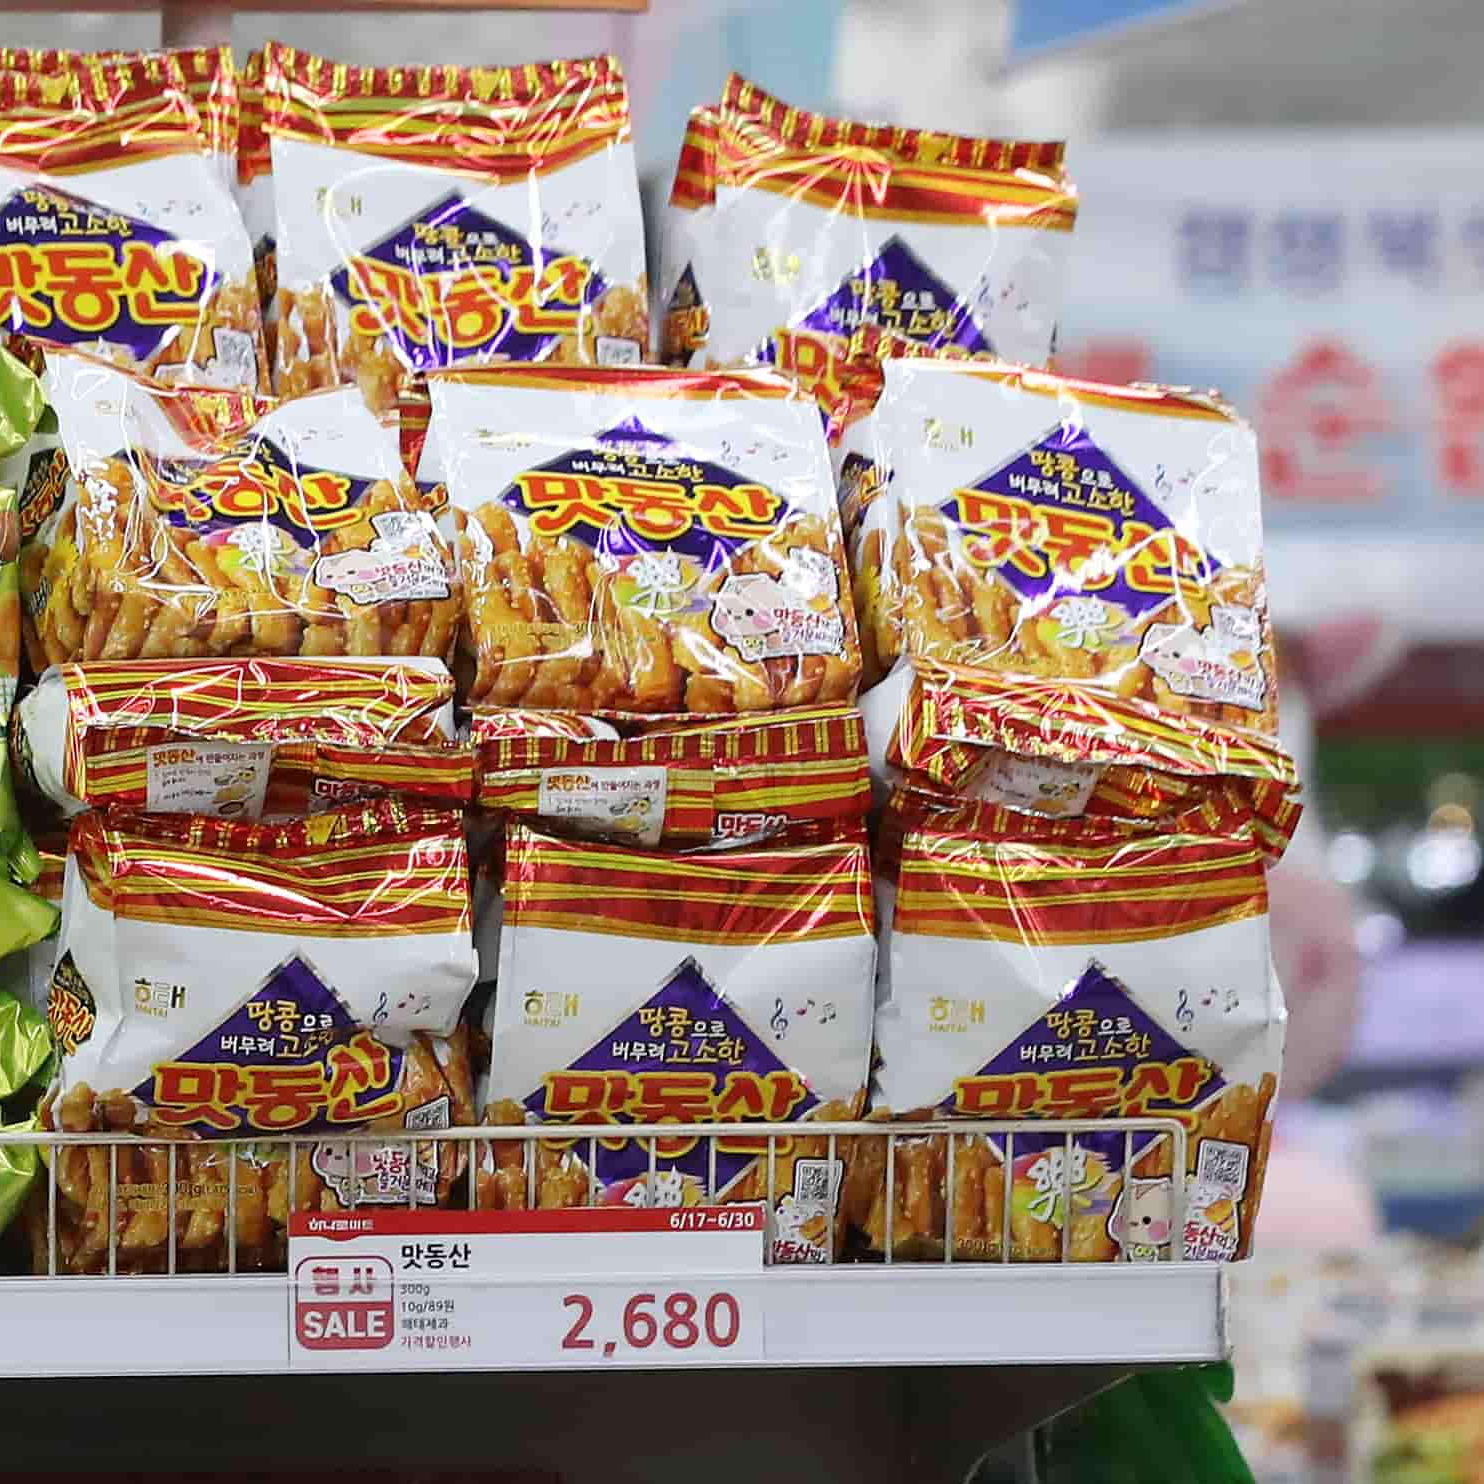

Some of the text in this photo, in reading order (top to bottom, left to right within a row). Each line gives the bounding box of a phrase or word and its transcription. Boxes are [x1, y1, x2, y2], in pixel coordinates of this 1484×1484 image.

[515, 471, 783, 541] 맛동산
[639, 1007, 727, 1038] 땅콩으로
[1046, 1010, 1133, 1037] 땅콩으로
[612, 1038, 745, 1064] 버무려 고소한
[151, 1031, 406, 1131] 맛동산
[542, 1069, 809, 1158] 맛동산
[670, 1210, 756, 1230] 6/17~6/30
[401, 1243, 472, 1270] 맛동산
[303, 1310, 387, 1340] SALE
[561, 1292, 741, 1358] 2,680
